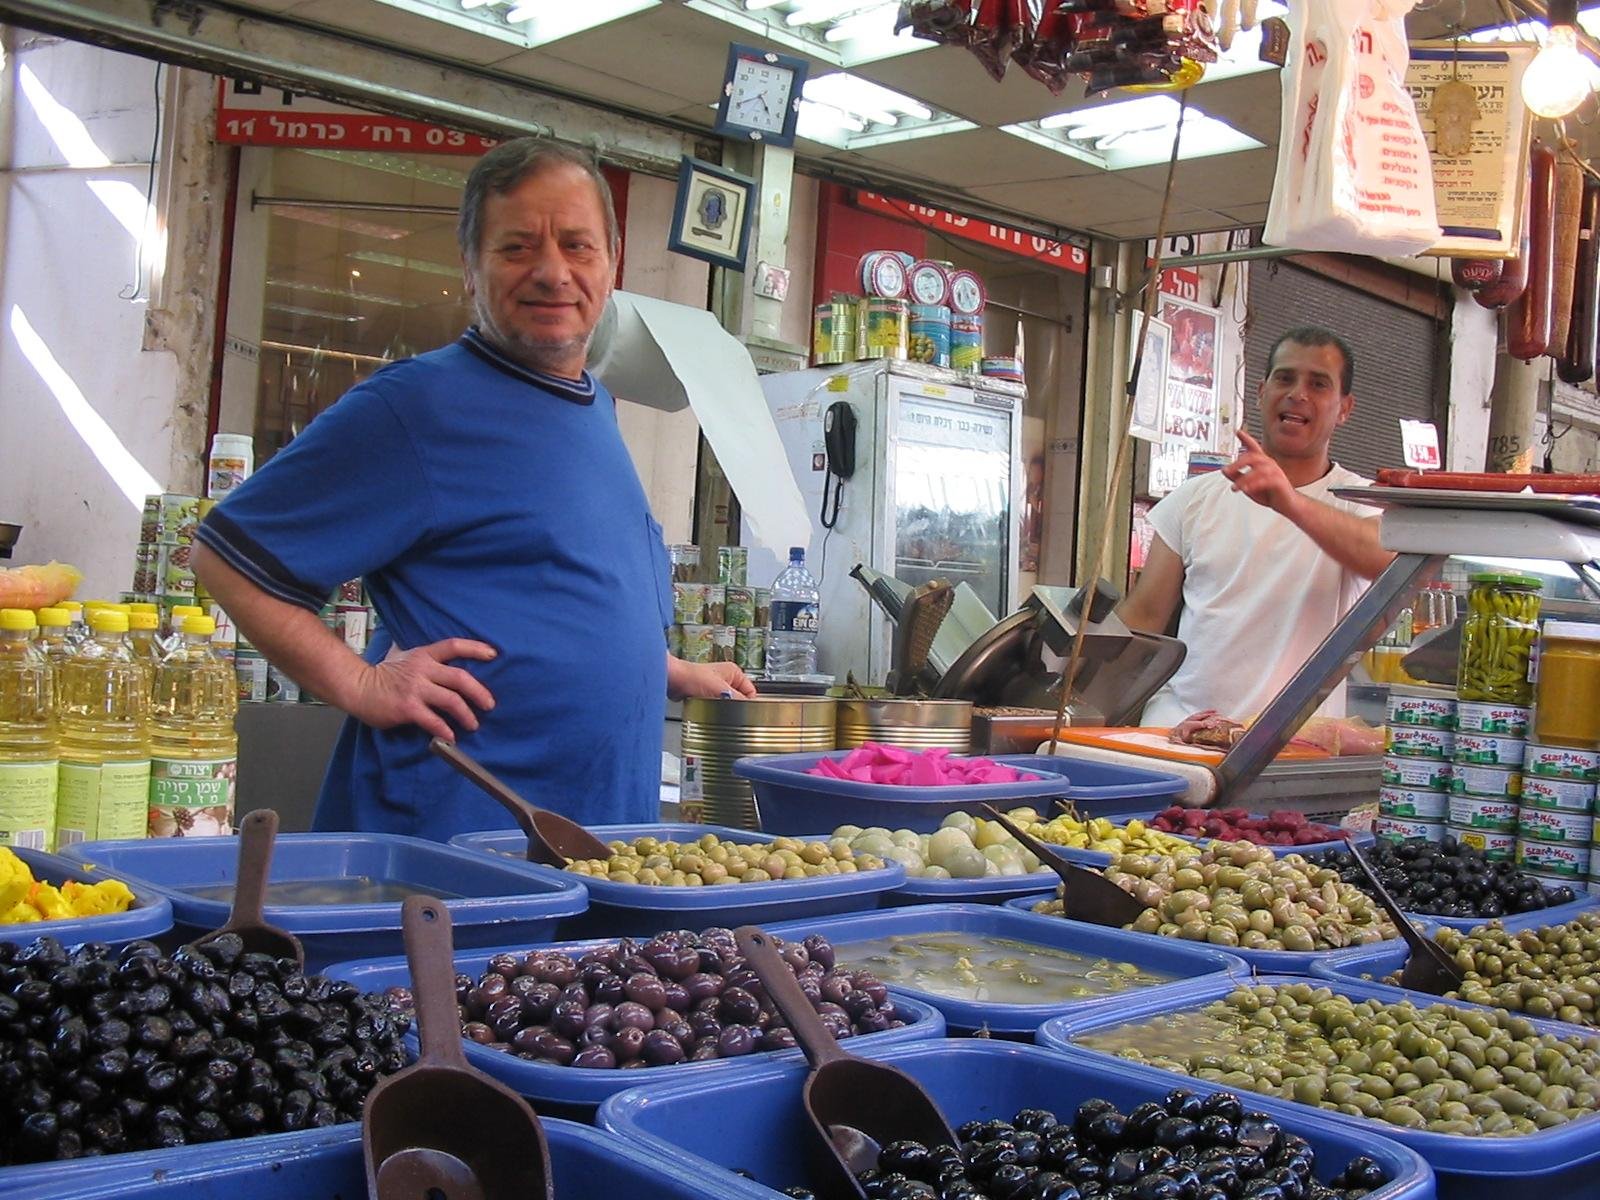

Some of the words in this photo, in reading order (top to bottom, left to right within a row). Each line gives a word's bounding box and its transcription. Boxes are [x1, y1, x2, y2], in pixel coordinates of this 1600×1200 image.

[226, 117, 256, 136] 11
[269, 116, 346, 140] כרמל
[425, 128, 466, 146] 03
[1492, 434, 1520, 454] 785
[182, 764, 209, 776] יצהר
[157, 780, 189, 792] סויה
[195, 781, 221, 796] שמן
